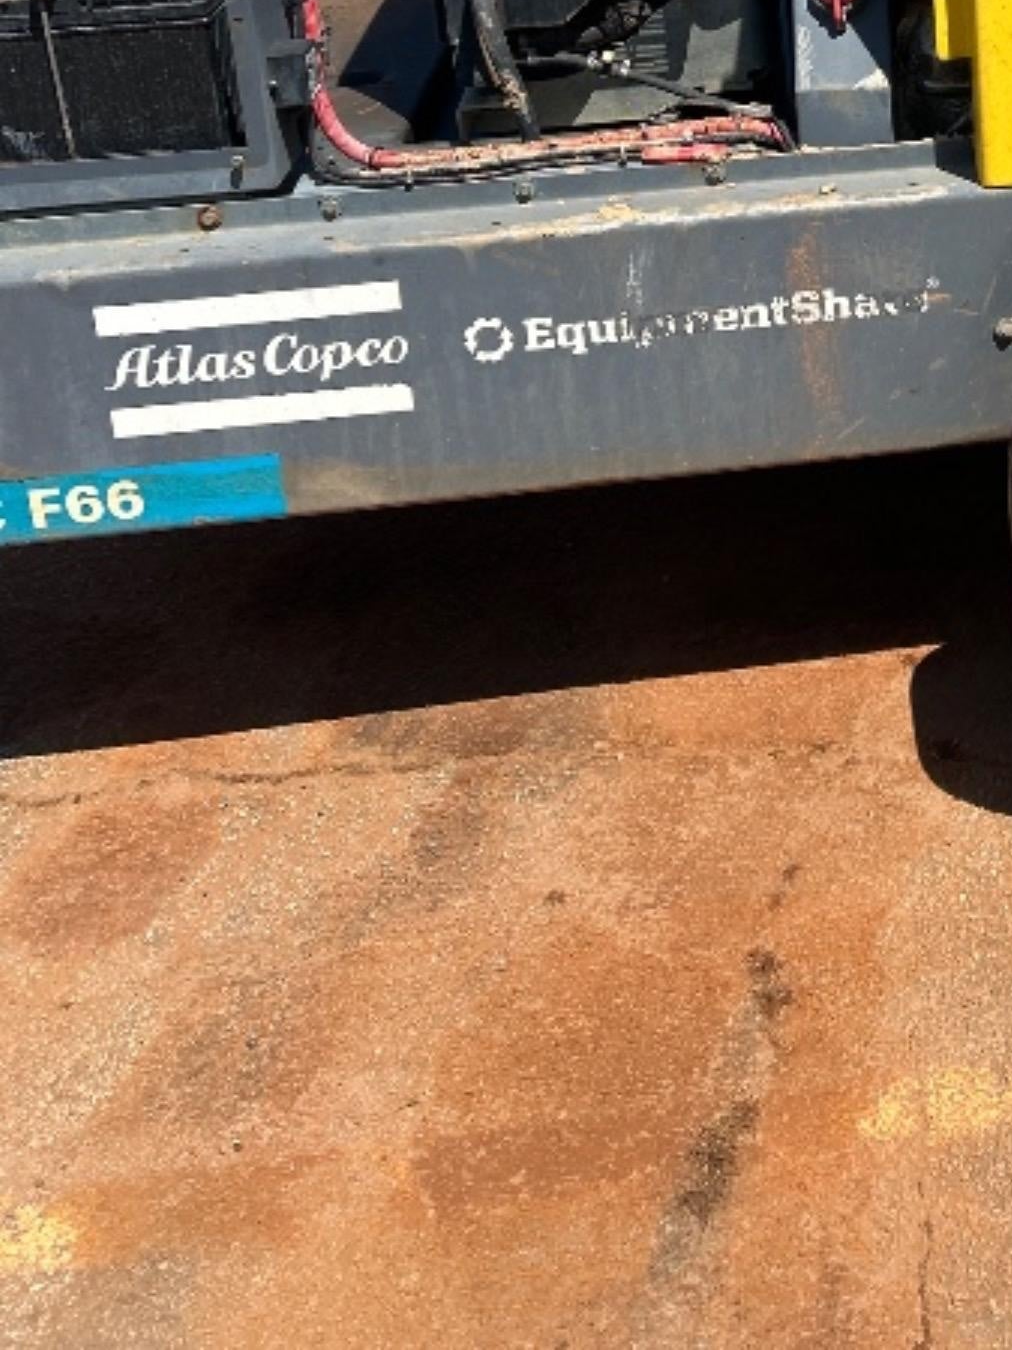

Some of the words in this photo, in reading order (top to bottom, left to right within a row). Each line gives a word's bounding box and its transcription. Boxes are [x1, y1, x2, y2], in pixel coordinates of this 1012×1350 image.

[105, 343, 257, 391] Atlas
[263, 332, 409, 380] Copco
[27, 479, 145, 530] F66
